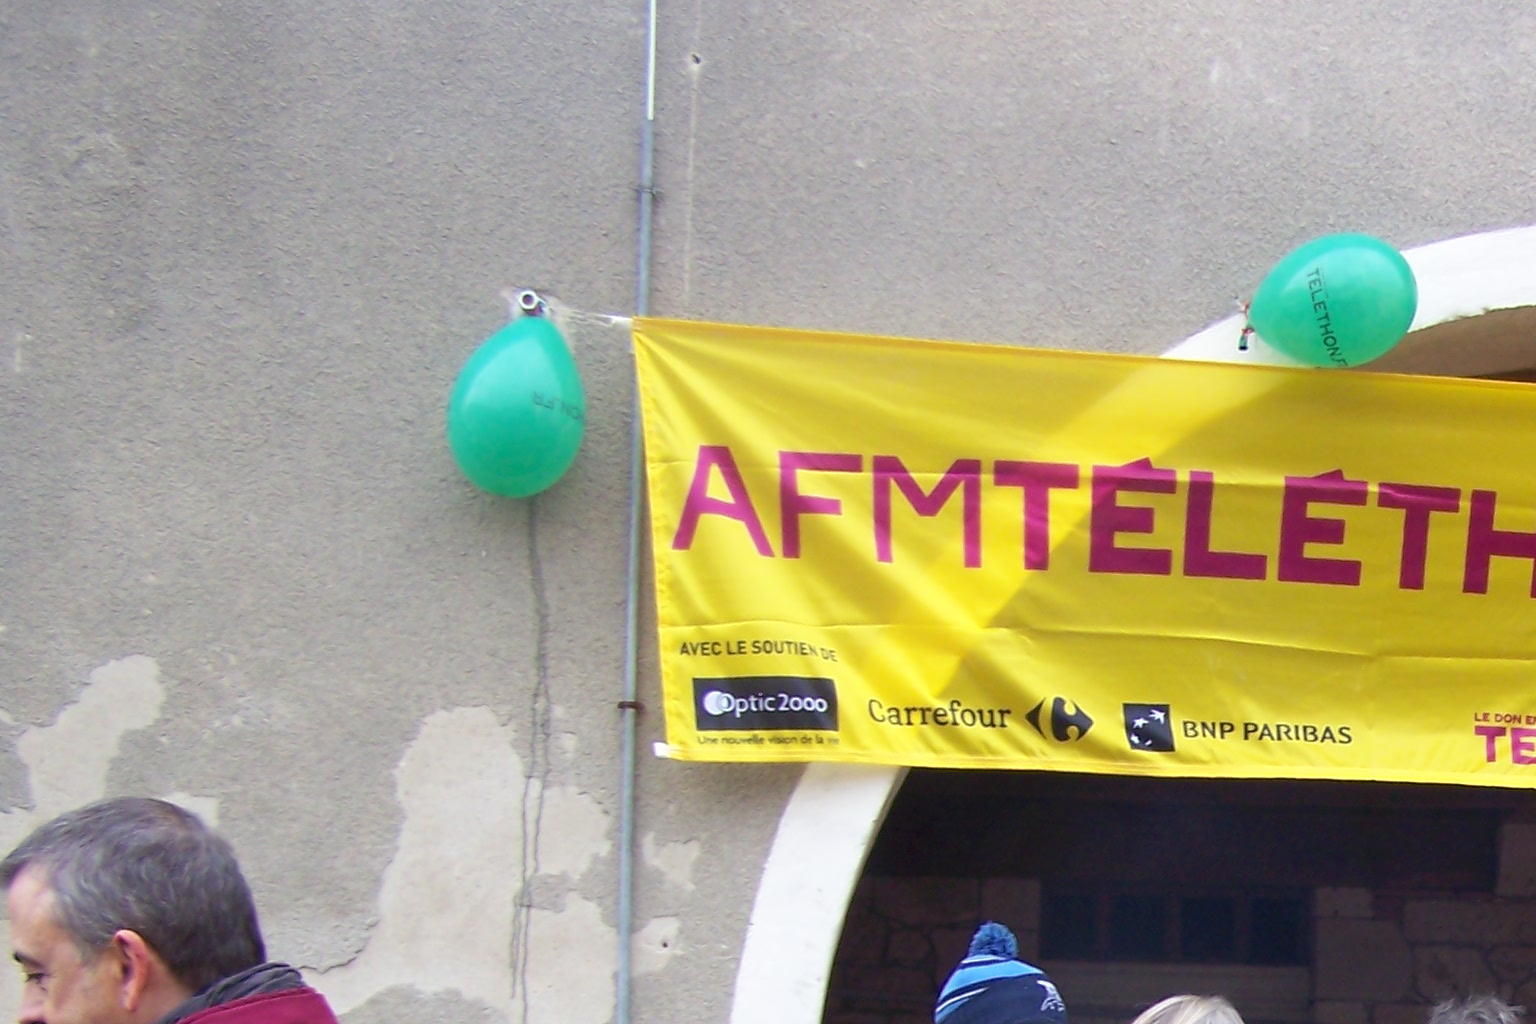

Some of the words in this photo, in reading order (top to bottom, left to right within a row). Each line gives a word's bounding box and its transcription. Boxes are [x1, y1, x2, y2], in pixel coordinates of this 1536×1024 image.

[680, 641, 722, 656] AVEC
[726, 640, 747, 655] LE
[751, 640, 819, 657] SOUTIEN
[820, 647, 839, 662] DE
[867, 698, 1012, 730] Carrefour
[1474, 712, 1491, 723] LE
[1494, 713, 1522, 726] DON
[721, 733, 764, 746] nouvelle
[767, 734, 798, 746] vision
[1182, 720, 1235, 740] BNP
[1242, 721, 1353, 745] PARIBAS
